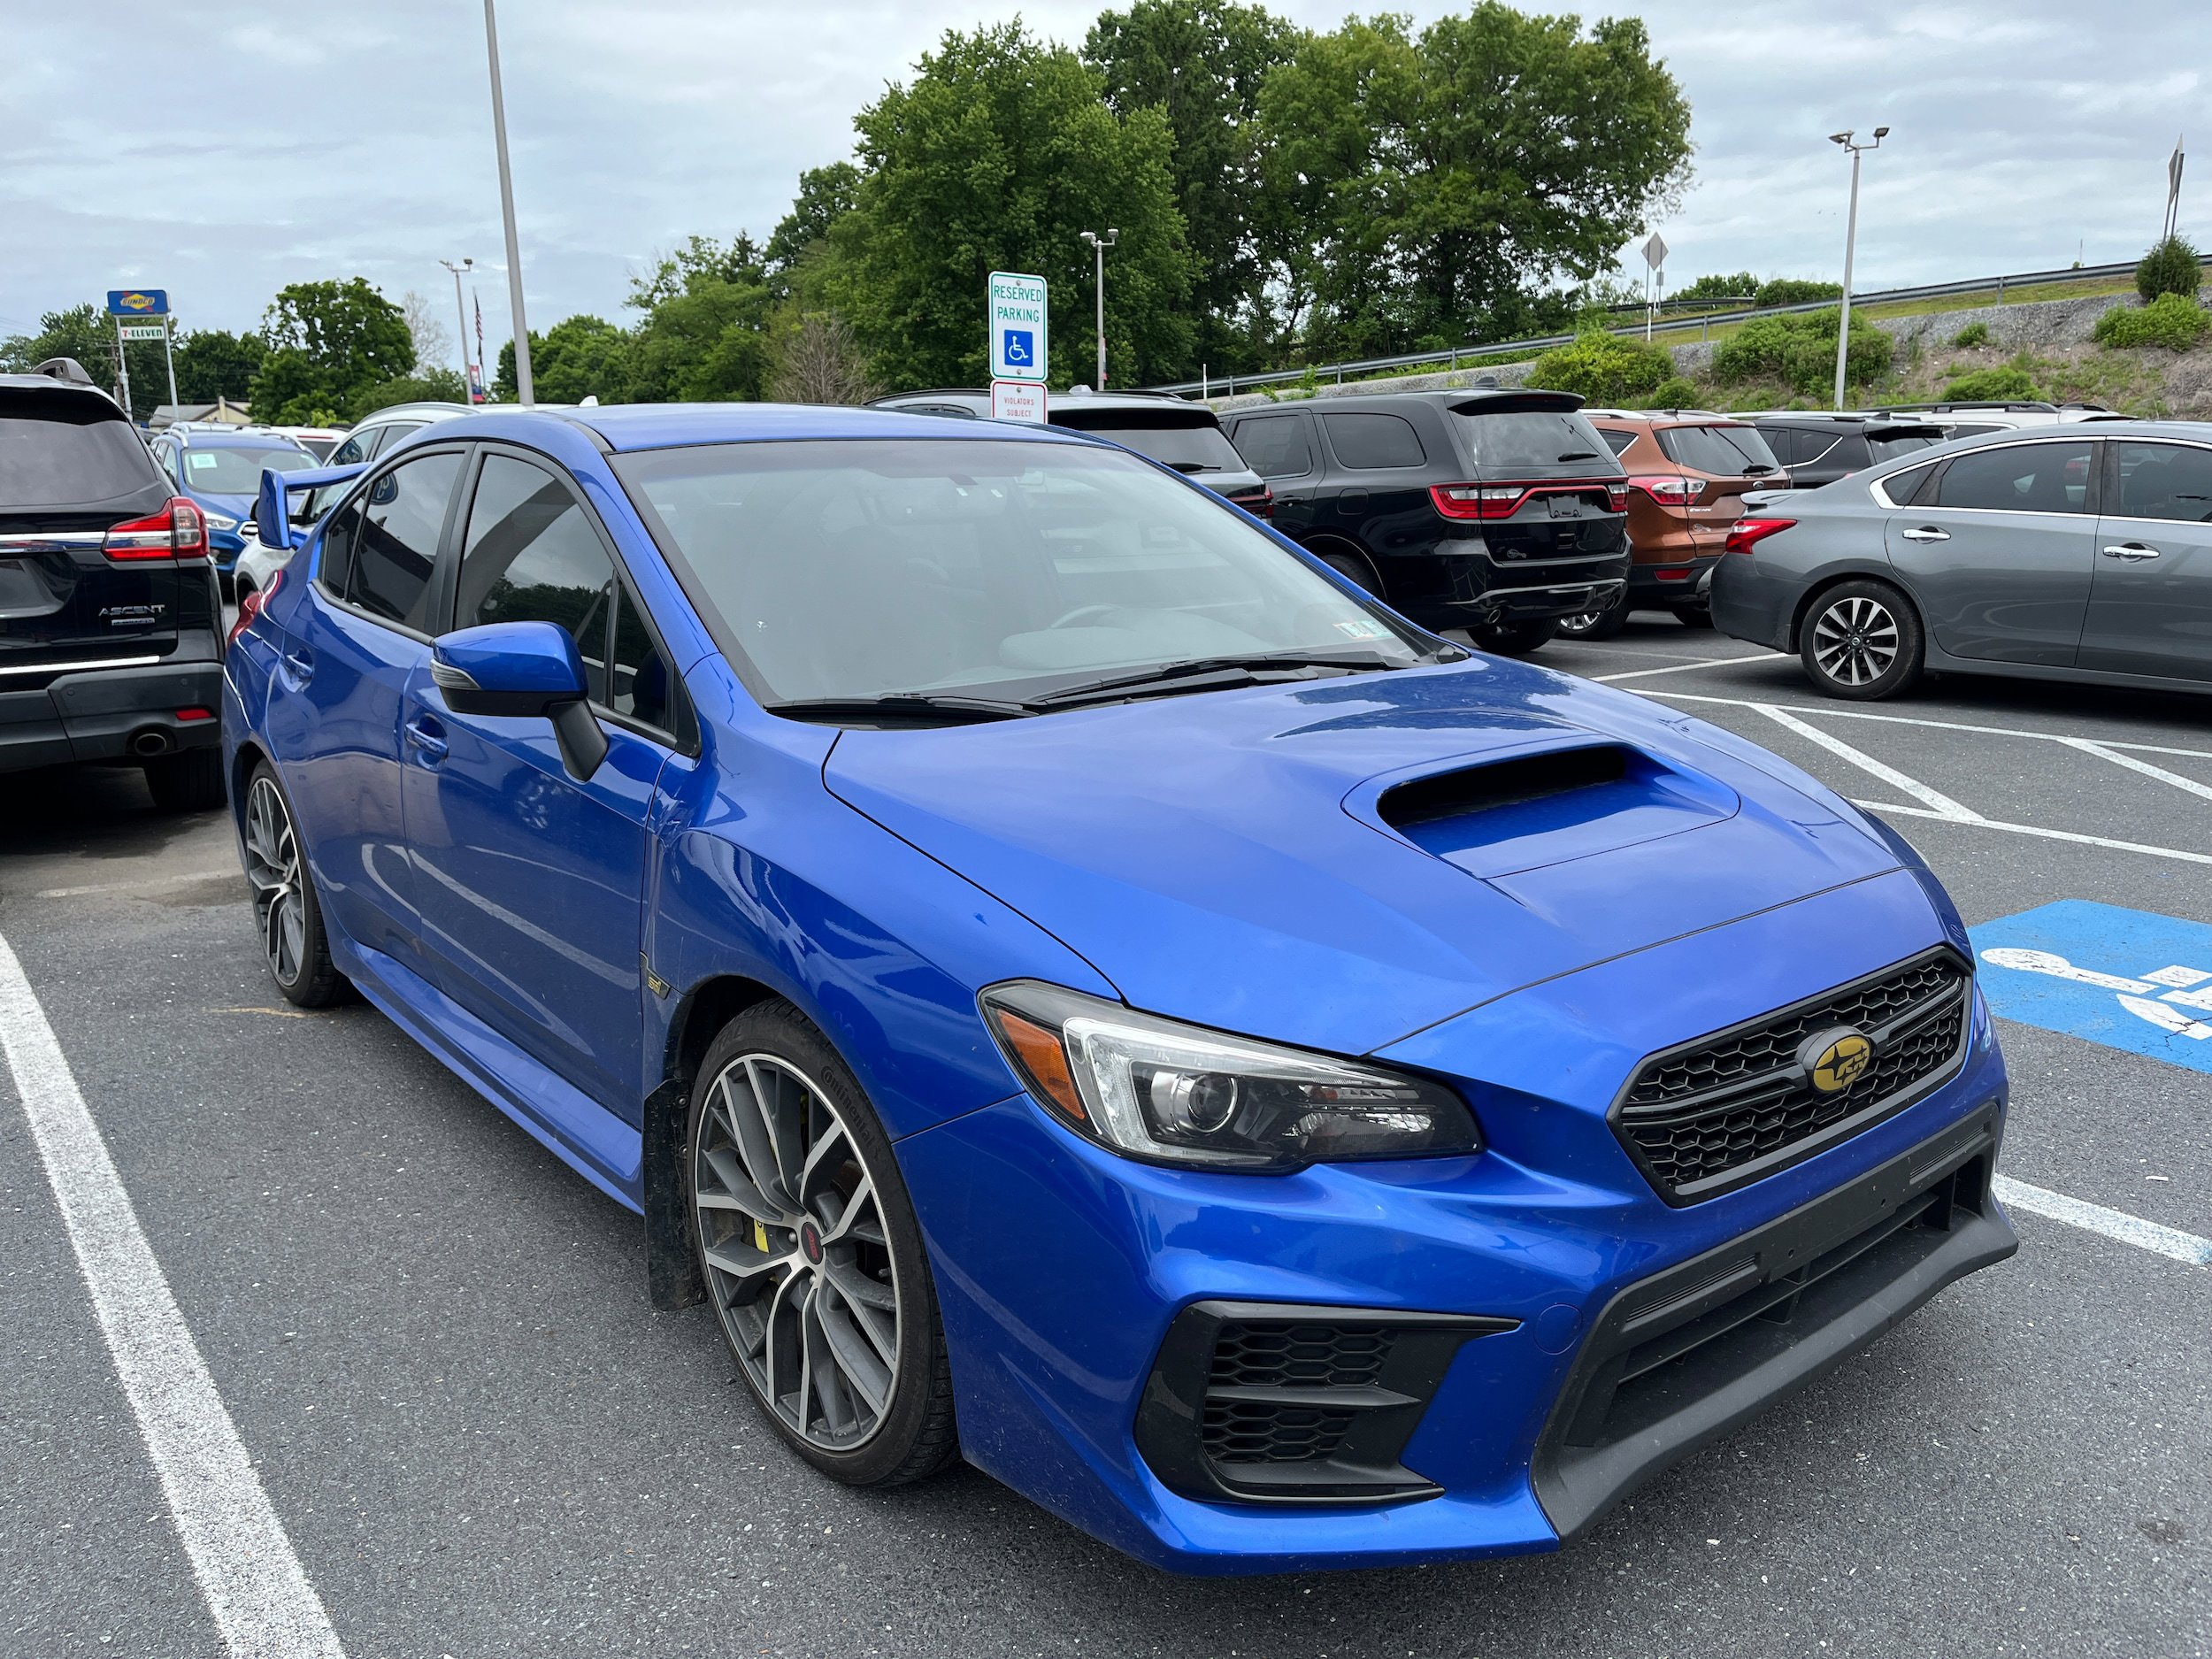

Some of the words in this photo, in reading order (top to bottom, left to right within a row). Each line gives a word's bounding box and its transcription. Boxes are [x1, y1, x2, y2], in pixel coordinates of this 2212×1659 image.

[120, 296, 155, 306] SUNOCO
[994, 285, 1042, 303] RESERVED
[997, 306, 1040, 323] PARKING
[1004, 396, 1034, 406] VIOLATORS
[1006, 409, 1032, 418] SUBJECT
[98, 603, 165, 617] ASCENT
[821, 1065, 876, 1147] Continental
